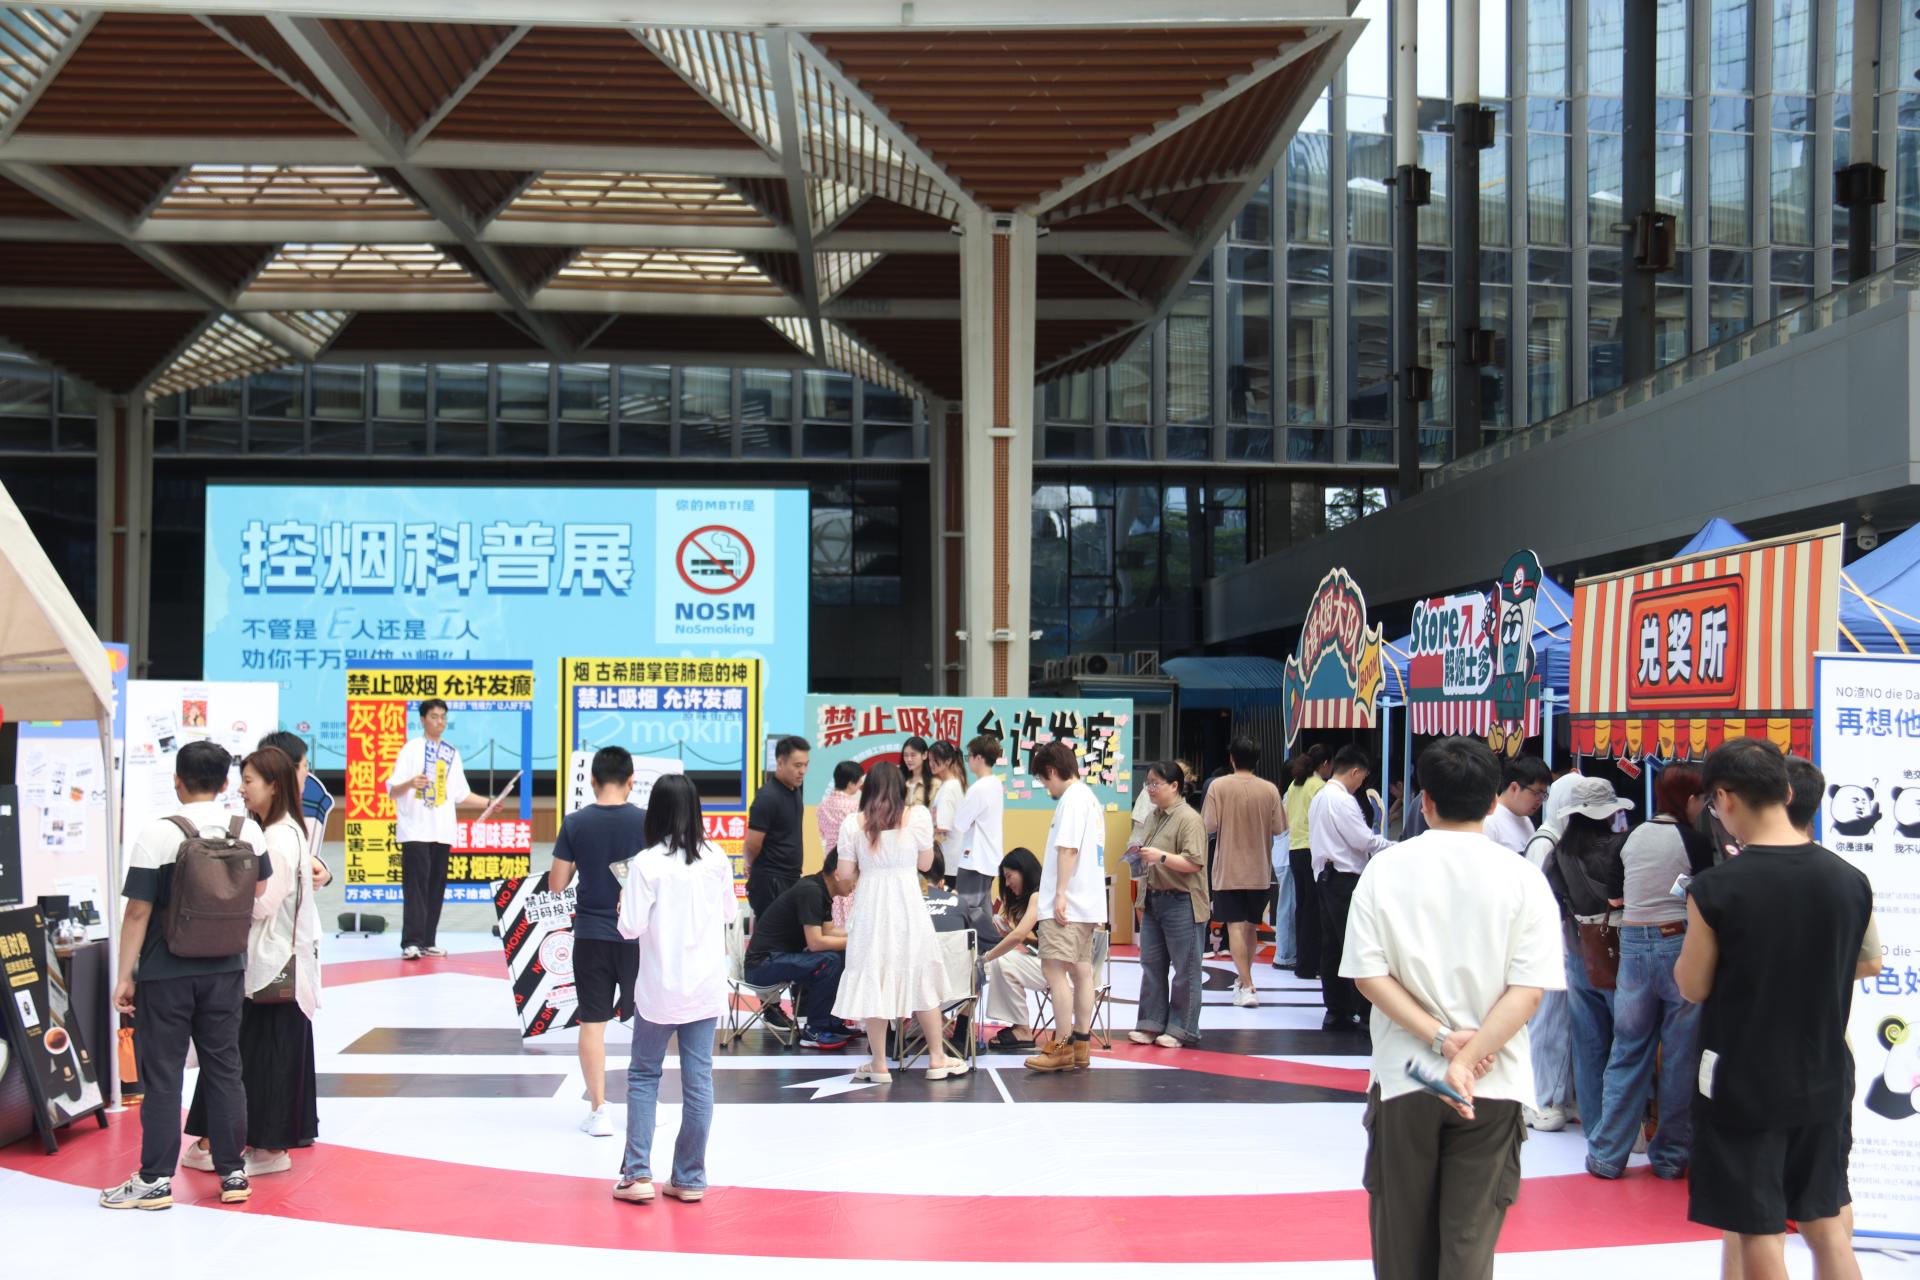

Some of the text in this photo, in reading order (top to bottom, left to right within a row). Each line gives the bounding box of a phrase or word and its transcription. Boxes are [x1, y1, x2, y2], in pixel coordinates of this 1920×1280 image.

[675, 499, 755, 512] 你的MBTI是
[241, 520, 634, 597] 控烟科普展
[675, 602, 755, 621] NOSM
[675, 624, 755, 637] NoSmoking
[1409, 603, 1460, 652] Store
[1636, 604, 1728, 687] 兑奖所
[574, 662, 748, 683] 烟 古希腊掌管肺癌的神
[348, 674, 532, 696] 禁止吸烟 允许发癫
[1885, 688, 1902, 699] die
[1905, 689, 1920, 700] Da
[577, 687, 742, 710] 禁止吸烟 允许发癫
[820, 705, 964, 748] 禁止吸烟
[348, 702, 377, 818] 灰飞烟灭
[470, 822, 531, 848] 烟味要去
[347, 888, 403, 900] 万水千山
[1892, 944, 1911, 957] die
